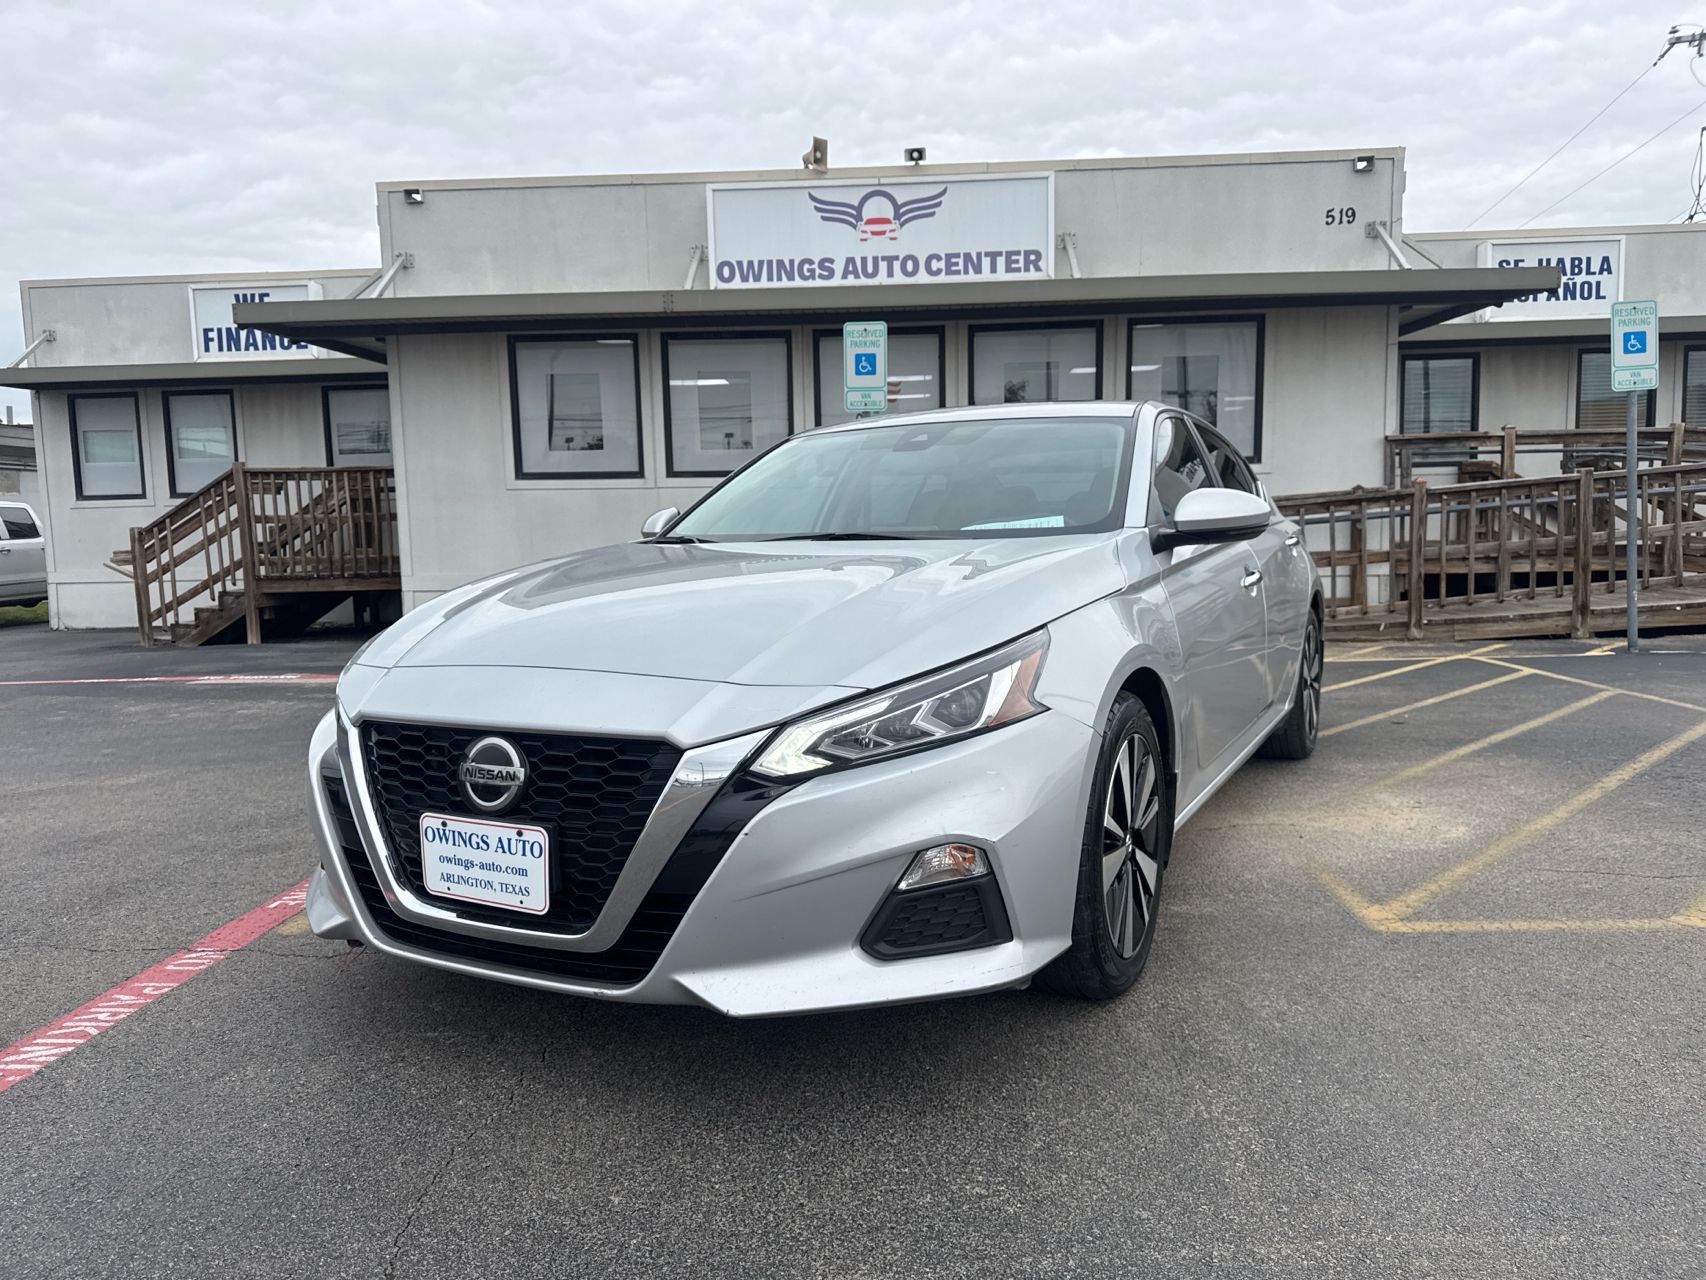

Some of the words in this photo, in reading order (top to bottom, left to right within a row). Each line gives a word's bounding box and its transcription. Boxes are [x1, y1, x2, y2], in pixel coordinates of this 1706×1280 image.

[1325, 207, 1356, 226] 519
[716, 256, 836, 284] OWINGS
[841, 253, 920, 280] AUTO
[924, 249, 1043, 277] CENTER
[1503, 277, 1607, 303] AÑOL
[1614, 306, 1655, 318] RESERVED
[1618, 317, 1651, 328] PARKING
[202, 326, 308, 353] FINAN
[845, 328, 884, 339] RESERVED
[849, 339, 881, 349] PARKING
[1617, 378, 1653, 387] ACCESIBLE
[849, 400, 883, 408] ACCESIBLE
[464, 767, 516, 782] NISSAN
[424, 825, 490, 852] OWINGS
[494, 836, 544, 859] AUTO
[438, 854, 529, 878] owings-auto.com
[439, 871, 497, 893] ARLINGTON,
[498, 881, 530, 898] TEXAS
